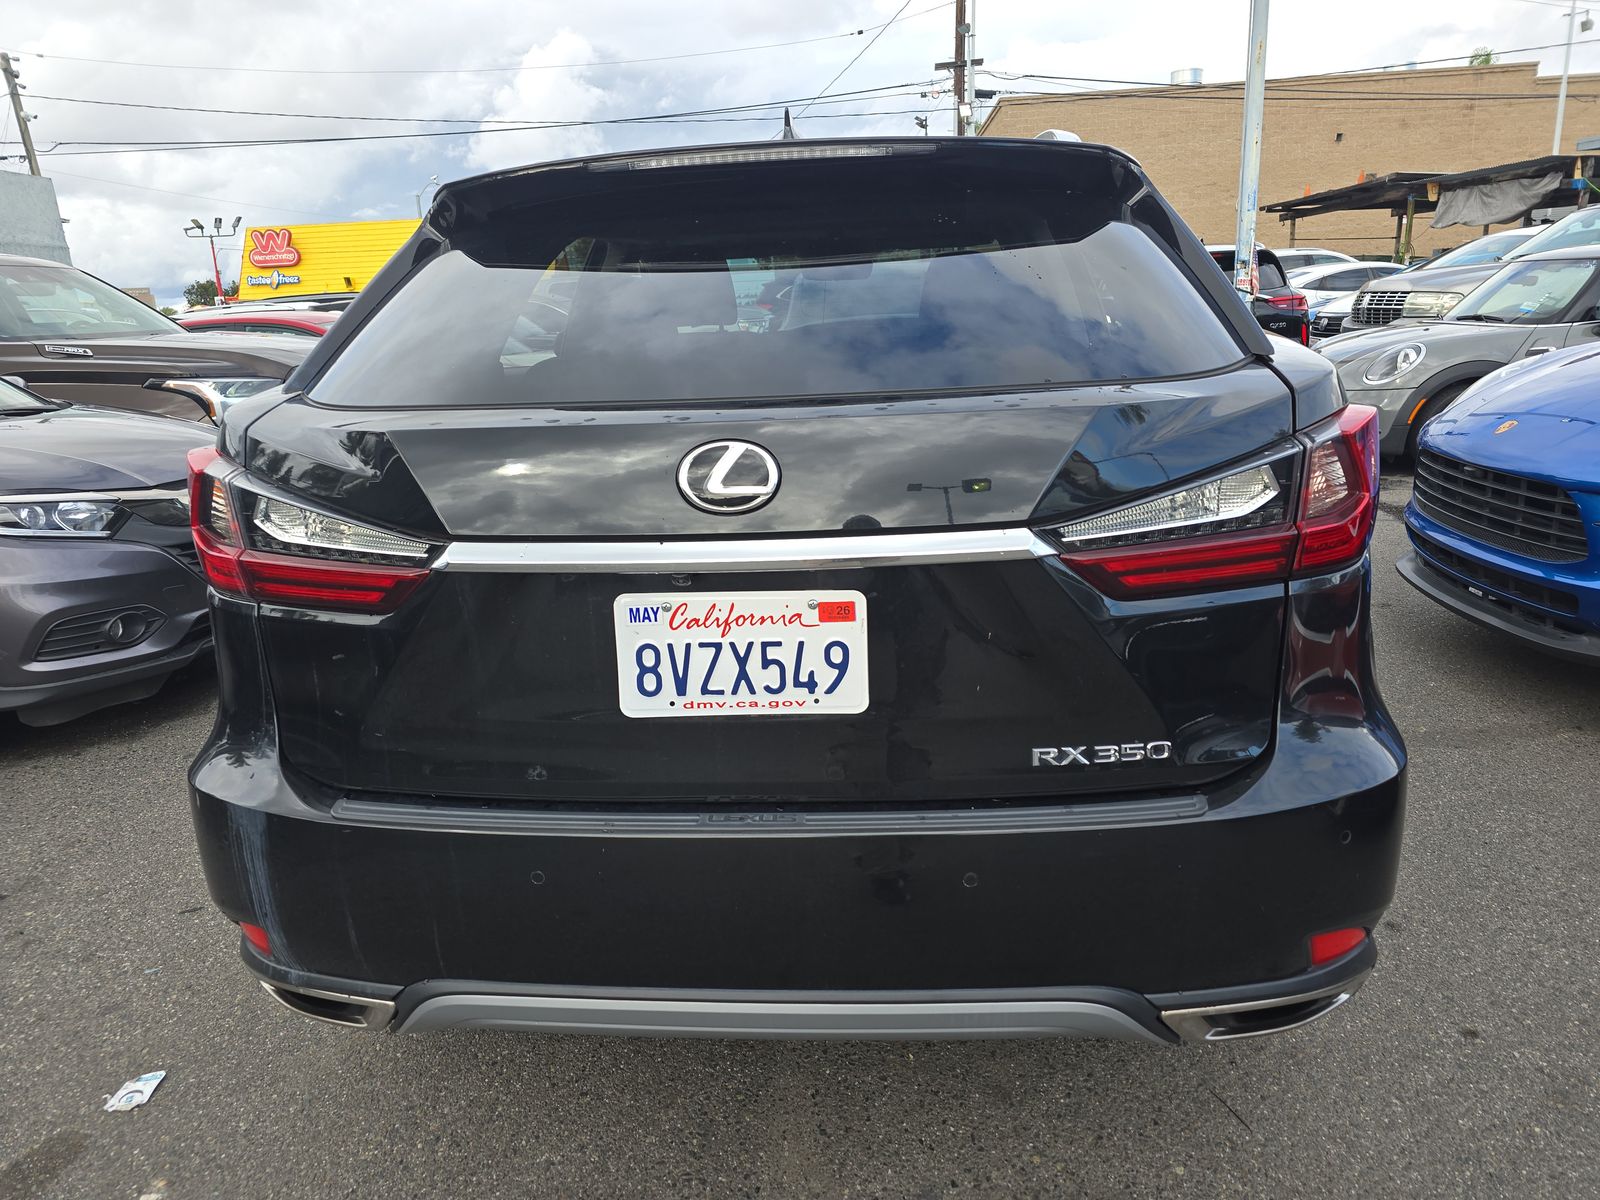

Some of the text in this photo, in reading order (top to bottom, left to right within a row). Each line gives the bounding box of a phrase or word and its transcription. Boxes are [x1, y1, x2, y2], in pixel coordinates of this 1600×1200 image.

[252, 229, 289, 253] W
[247, 274, 300, 286] tastee freez
[628, 606, 661, 624] MAY
[836, 605, 851, 616] 26
[668, 602, 820, 638] California
[635, 640, 850, 698] 8VZX549
[683, 700, 807, 710] dmv.ca.gov
[1032, 741, 1172, 767] RX 350
[707, 813, 798, 823] LEXUS
